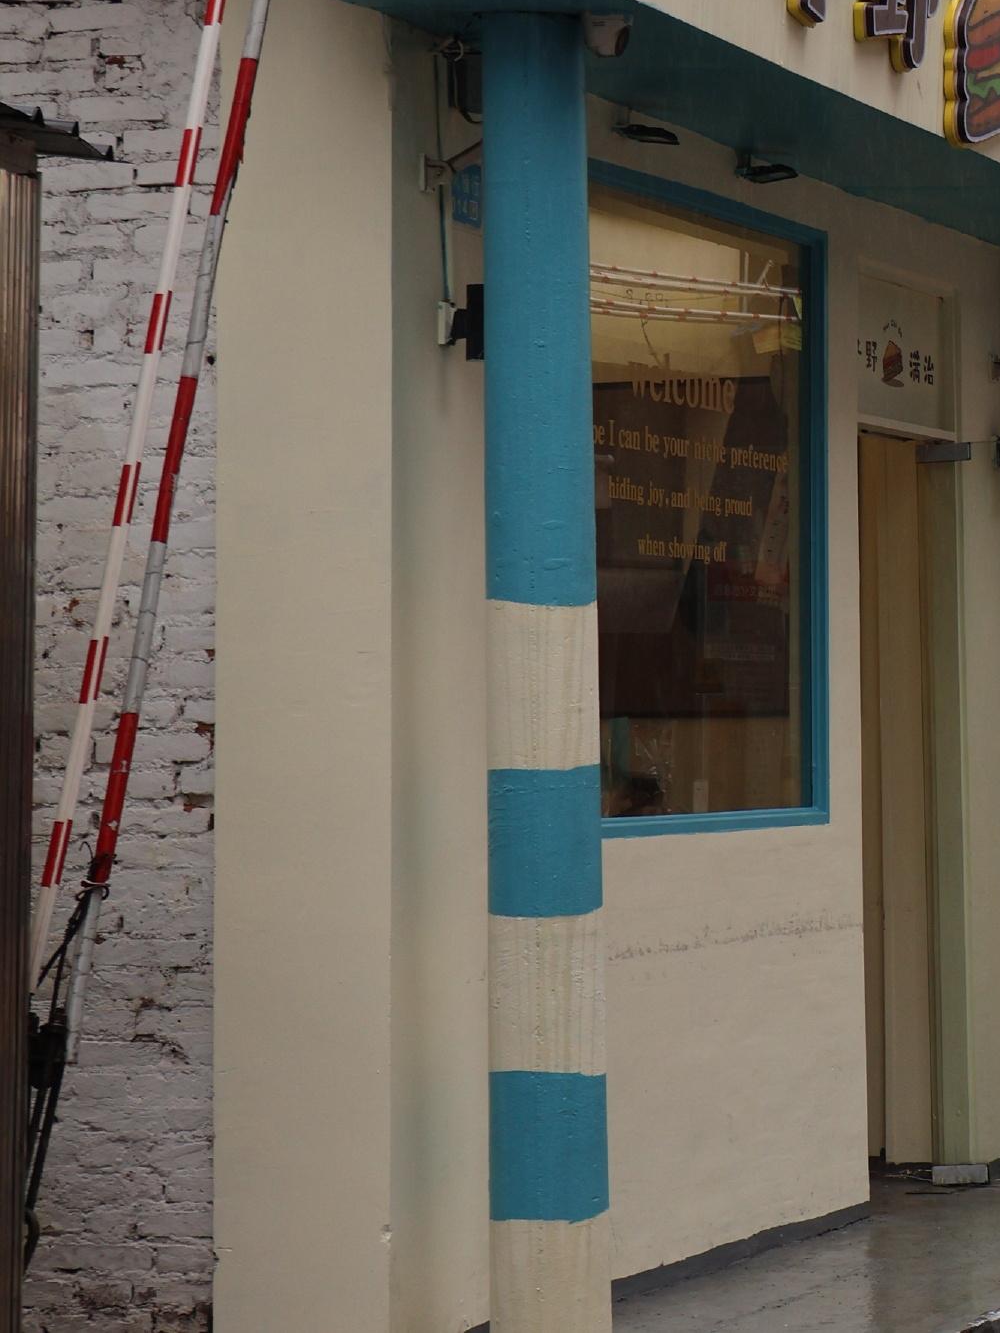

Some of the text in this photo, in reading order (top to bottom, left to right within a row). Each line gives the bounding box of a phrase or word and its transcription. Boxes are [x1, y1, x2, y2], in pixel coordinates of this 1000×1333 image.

[628, 353, 736, 415] welcome
[608, 419, 616, 447] I
[618, 427, 641, 450] can
[645, 425, 660, 453] be
[663, 434, 690, 459] your
[694, 436, 726, 464] niche
[730, 444, 788, 473] preference
[608, 475, 644, 506] hiding
[694, 489, 721, 515] being
[724, 496, 753, 517] proud
[637, 533, 728, 564] when showing off
